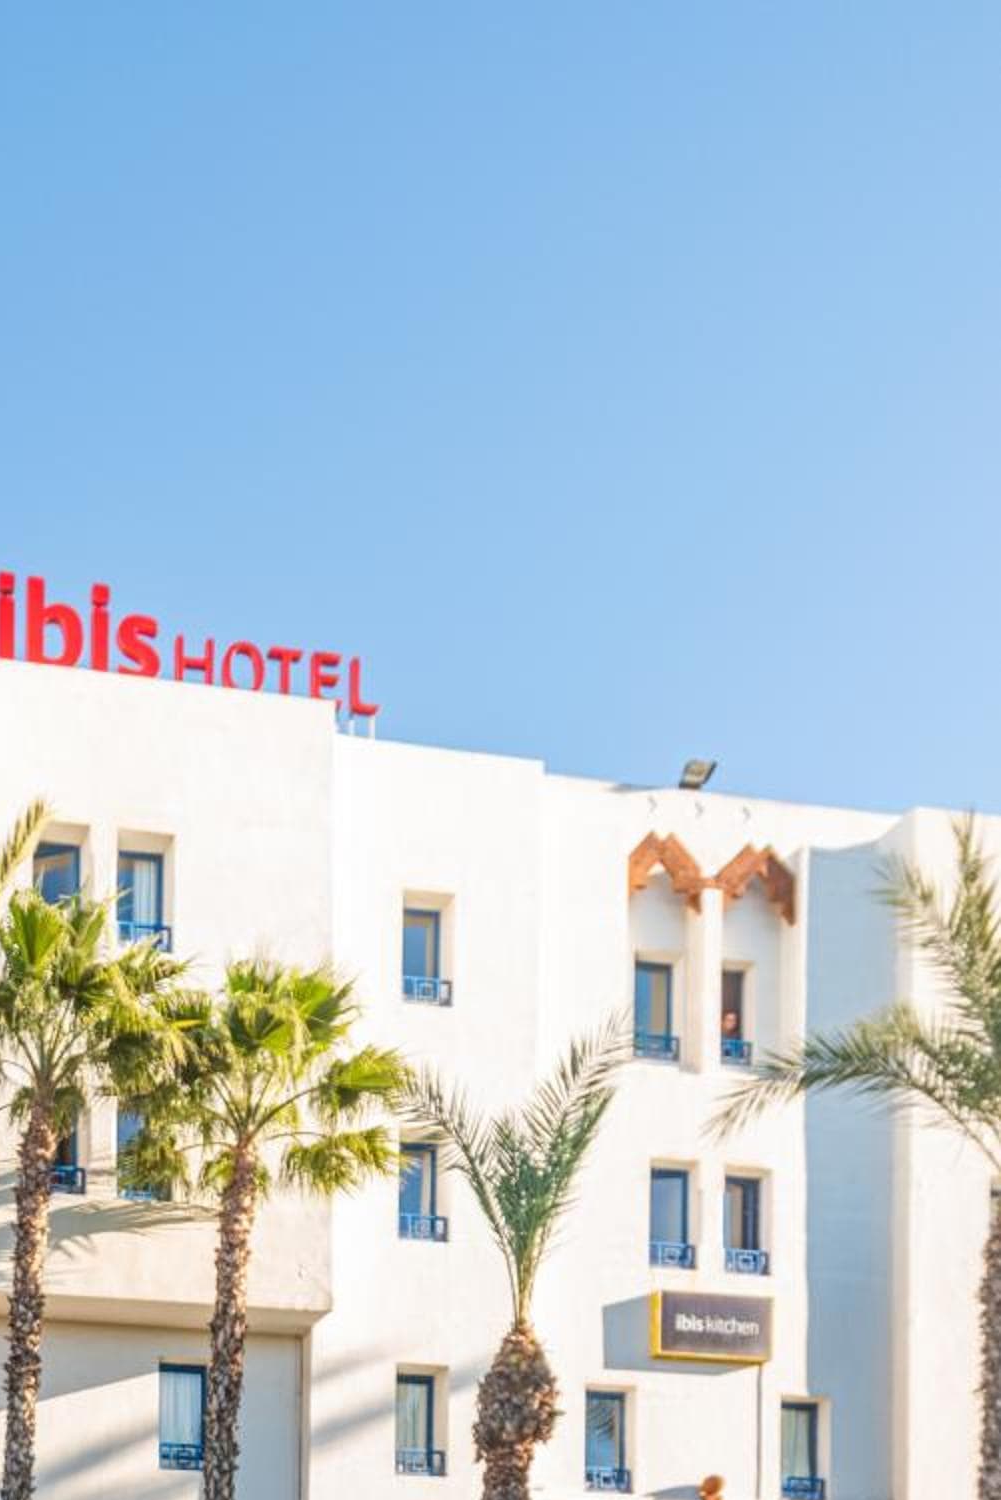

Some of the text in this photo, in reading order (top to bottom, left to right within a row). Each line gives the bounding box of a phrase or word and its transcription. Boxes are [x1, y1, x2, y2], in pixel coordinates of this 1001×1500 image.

[174, 634, 379, 717] HOTEL
[675, 1313, 760, 1337] ibis kitchen
